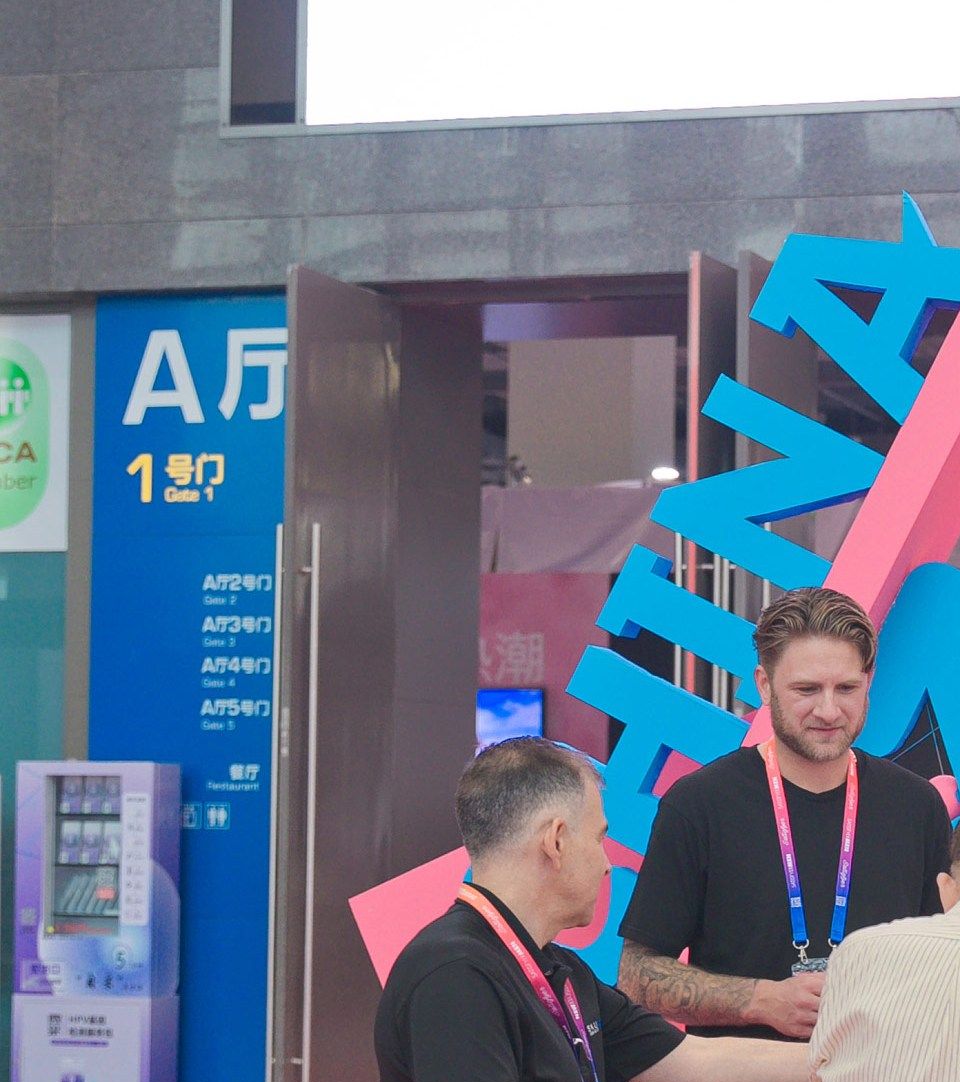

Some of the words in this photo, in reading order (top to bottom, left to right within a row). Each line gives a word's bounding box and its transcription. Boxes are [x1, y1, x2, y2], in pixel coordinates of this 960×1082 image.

[0, 474, 38, 490] ber
[203, 485, 214, 503] 1
[479, 632, 544, 682] 潮
